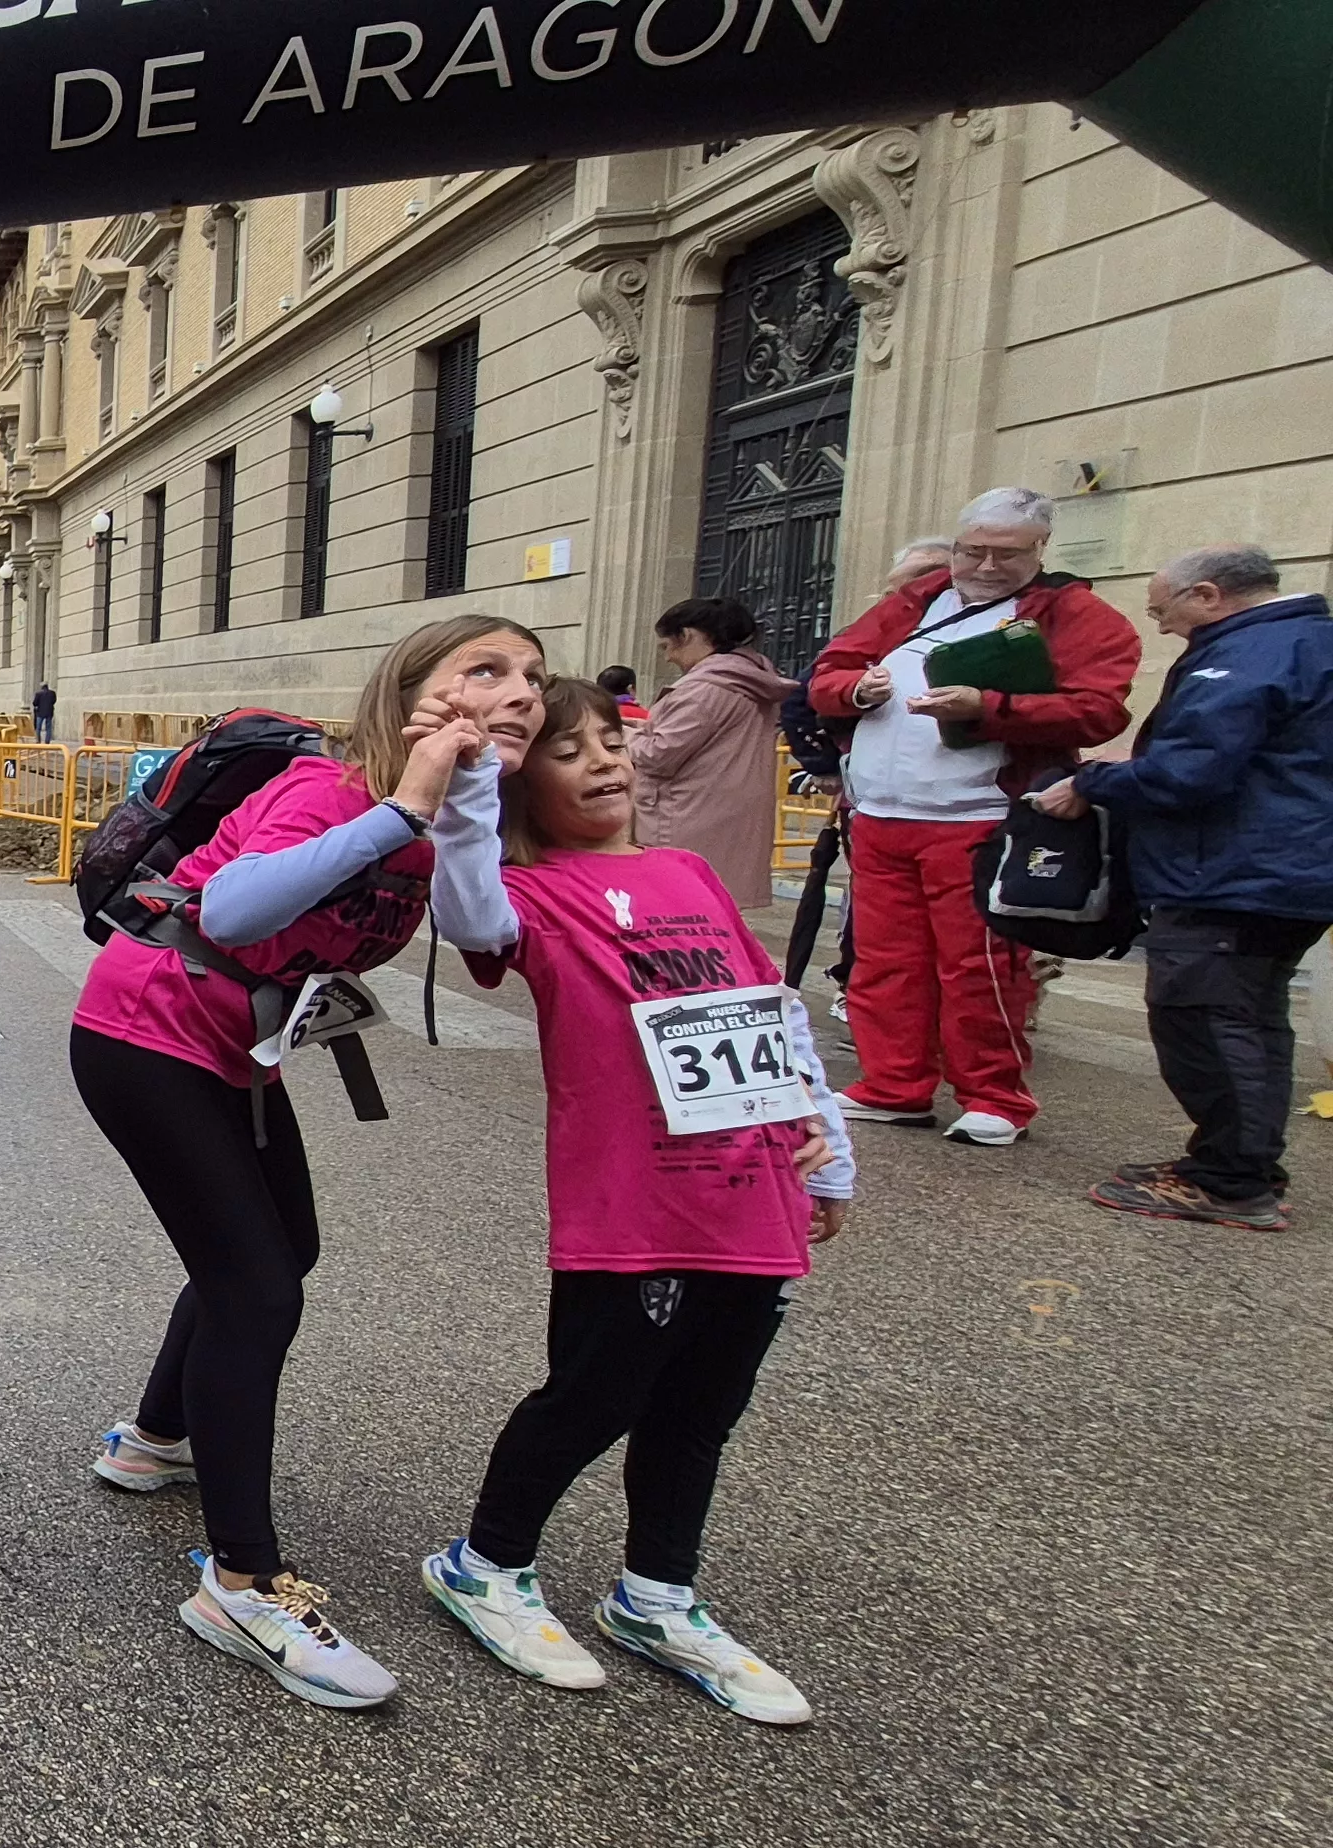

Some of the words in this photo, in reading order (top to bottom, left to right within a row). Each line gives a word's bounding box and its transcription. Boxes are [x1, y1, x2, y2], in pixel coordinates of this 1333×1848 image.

[50, 50, 205, 150] DE
[662, 1018, 727, 1039] CONTRA
[726, 1015, 746, 1029] EL
[706, 1003, 752, 1018] HUESCA
[668, 1030, 794, 1093] 3142
